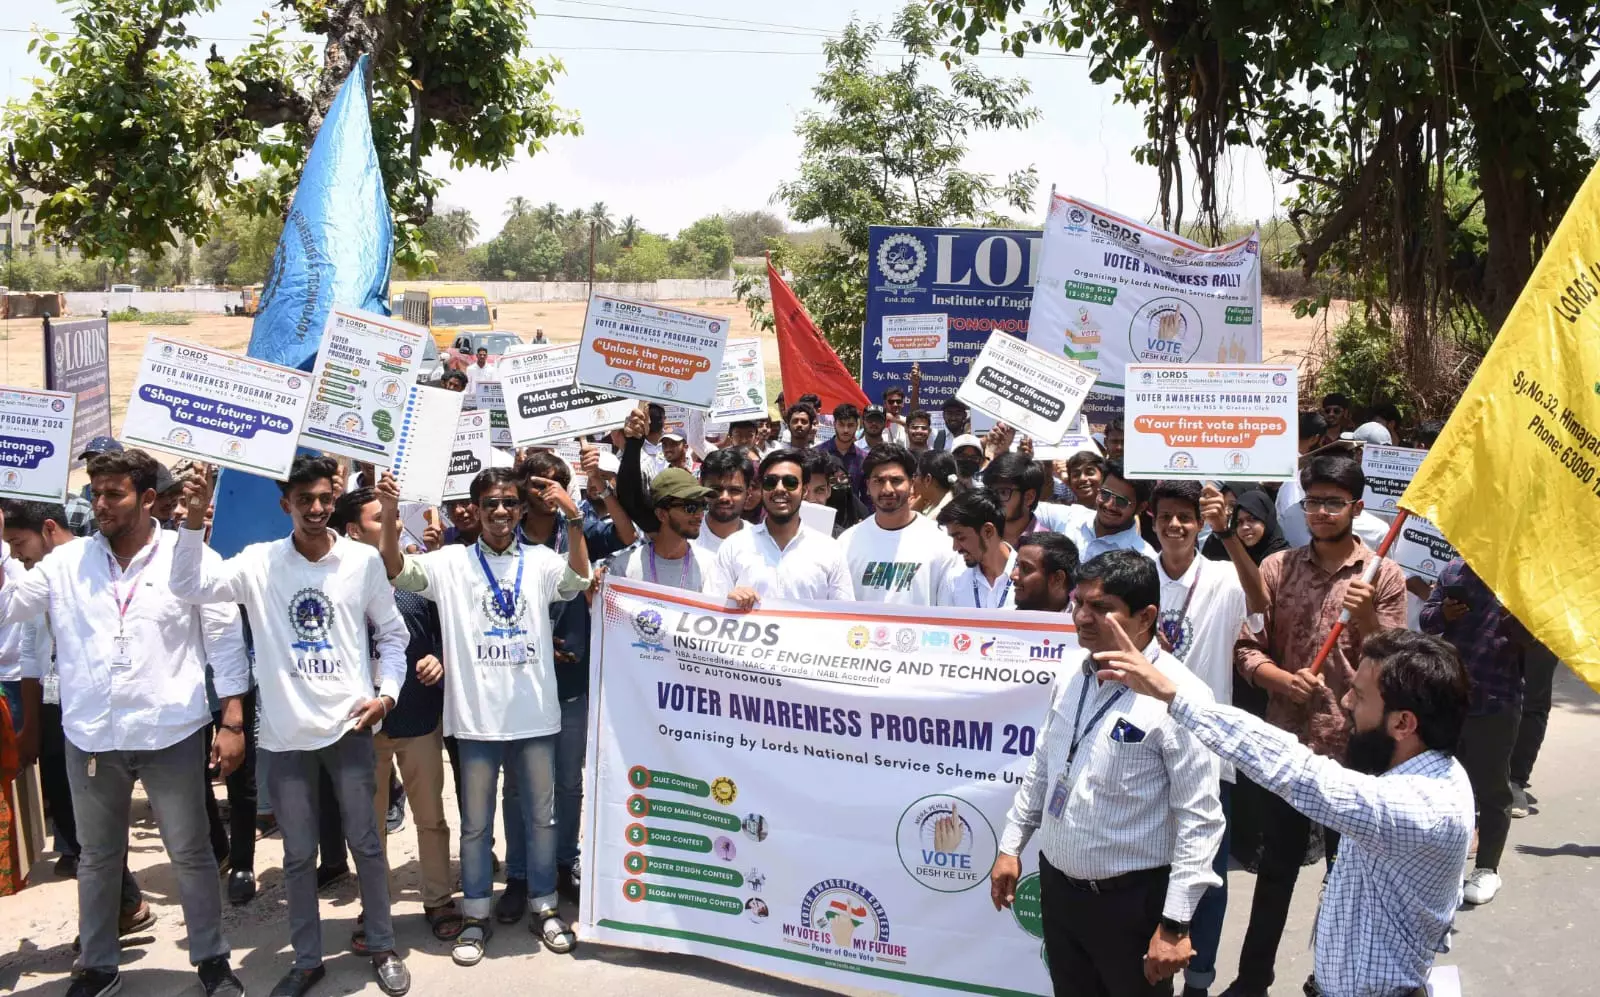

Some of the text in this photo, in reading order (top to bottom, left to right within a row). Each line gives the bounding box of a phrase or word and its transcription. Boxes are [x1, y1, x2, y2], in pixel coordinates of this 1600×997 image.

[1090, 214, 1142, 245] LORDS
[1103, 251, 1139, 272] VOTER
[1212, 273, 1241, 288] RALLY
[1067, 281, 1116, 295] Polling Date
[1073, 268, 1117, 284] Organising
[1118, 274, 1130, 286] by
[1131, 278, 1151, 288] Lords
[1153, 282, 1187, 296] National
[295, 271, 320, 342] TECHNOLOGY
[932, 294, 985, 308] Institute
[986, 295, 999, 308] of
[1554, 271, 1600, 324] LORDS
[616, 302, 642, 314] LORDS
[346, 319, 368, 330] LORDS
[595, 318, 718, 348] VOTER AWARENESS PROGRAM 2024
[329, 342, 363, 356] AWARENESS
[331, 334, 349, 344] VOTER
[1008, 341, 1028, 354] LORDS
[1147, 337, 1182, 354] VOTE
[64, 327, 106, 372] LORDS
[177, 347, 209, 361] LORDS
[327, 349, 355, 363] PROGRAM
[523, 353, 549, 363] LORDS
[597, 340, 709, 370] "Unlock the power of
[1140, 351, 1159, 360] DESH
[609, 355, 690, 377] your first vote!"
[987, 350, 1037, 375] VOTER AWARENESS
[151, 363, 298, 407] VOTER AWARENESS PROGRAM 2024
[509, 367, 574, 385] VOTER AWARENESS
[872, 371, 885, 381] Sy.
[886, 371, 901, 380] No.
[1156, 371, 1189, 379] LORDS
[381, 391, 398, 402] VOTE
[523, 391, 558, 404] "Make
[978, 376, 1032, 408] from day one,
[987, 368, 1013, 387] "Make
[1019, 384, 1061, 410] difference
[1135, 393, 1288, 404] VOTER AWARENESS PROGRAM 2024
[1512, 370, 1559, 421] Sy.No.32,
[144, 386, 290, 430] "Shape our future: Vote
[522, 396, 594, 416] from day one,
[1, 414, 63, 430] PROGRAM 2024
[175, 408, 252, 433] for society!"
[1139, 417, 1283, 433] "Your first vote shapes
[1169, 432, 1250, 446] your future!"
[1527, 414, 1595, 484] Phone: 63090
[1408, 531, 1429, 543] "Start
[675, 611, 781, 647] LORDS
[673, 635, 748, 658] INSTITUTE
[751, 646, 773, 660] OF
[776, 649, 892, 673] ENGINEERING
[897, 660, 935, 677] AND
[1029, 637, 1067, 659] nirf
[692, 653, 735, 667] Accredited
[679, 662, 783, 687] UGC AUTONOMOUS
[656, 681, 722, 717] VOTER
[729, 693, 862, 738] AWARENESS
[870, 711, 993, 752] PROGRAM
[658, 723, 997, 783] Organising by Lords National Service Scheme
[635, 771, 700, 791] 1 QUIZ CONTEST
[633, 801, 731, 825] 2 VIDEO MAKING CONTEST
[632, 829, 704, 846] 3 SONG CONTEST
[922, 849, 972, 869] VOTE
[631, 858, 734, 881] 4 POSTER DESIGN CONTEST
[916, 866, 977, 881] DESH KE LIYE
[629, 885, 741, 910] 5 SLOGAN WRITING CONTEST
[782, 923, 907, 958] MY VOTE IS MY FUTURE
[811, 943, 875, 962] Power of One Vote
